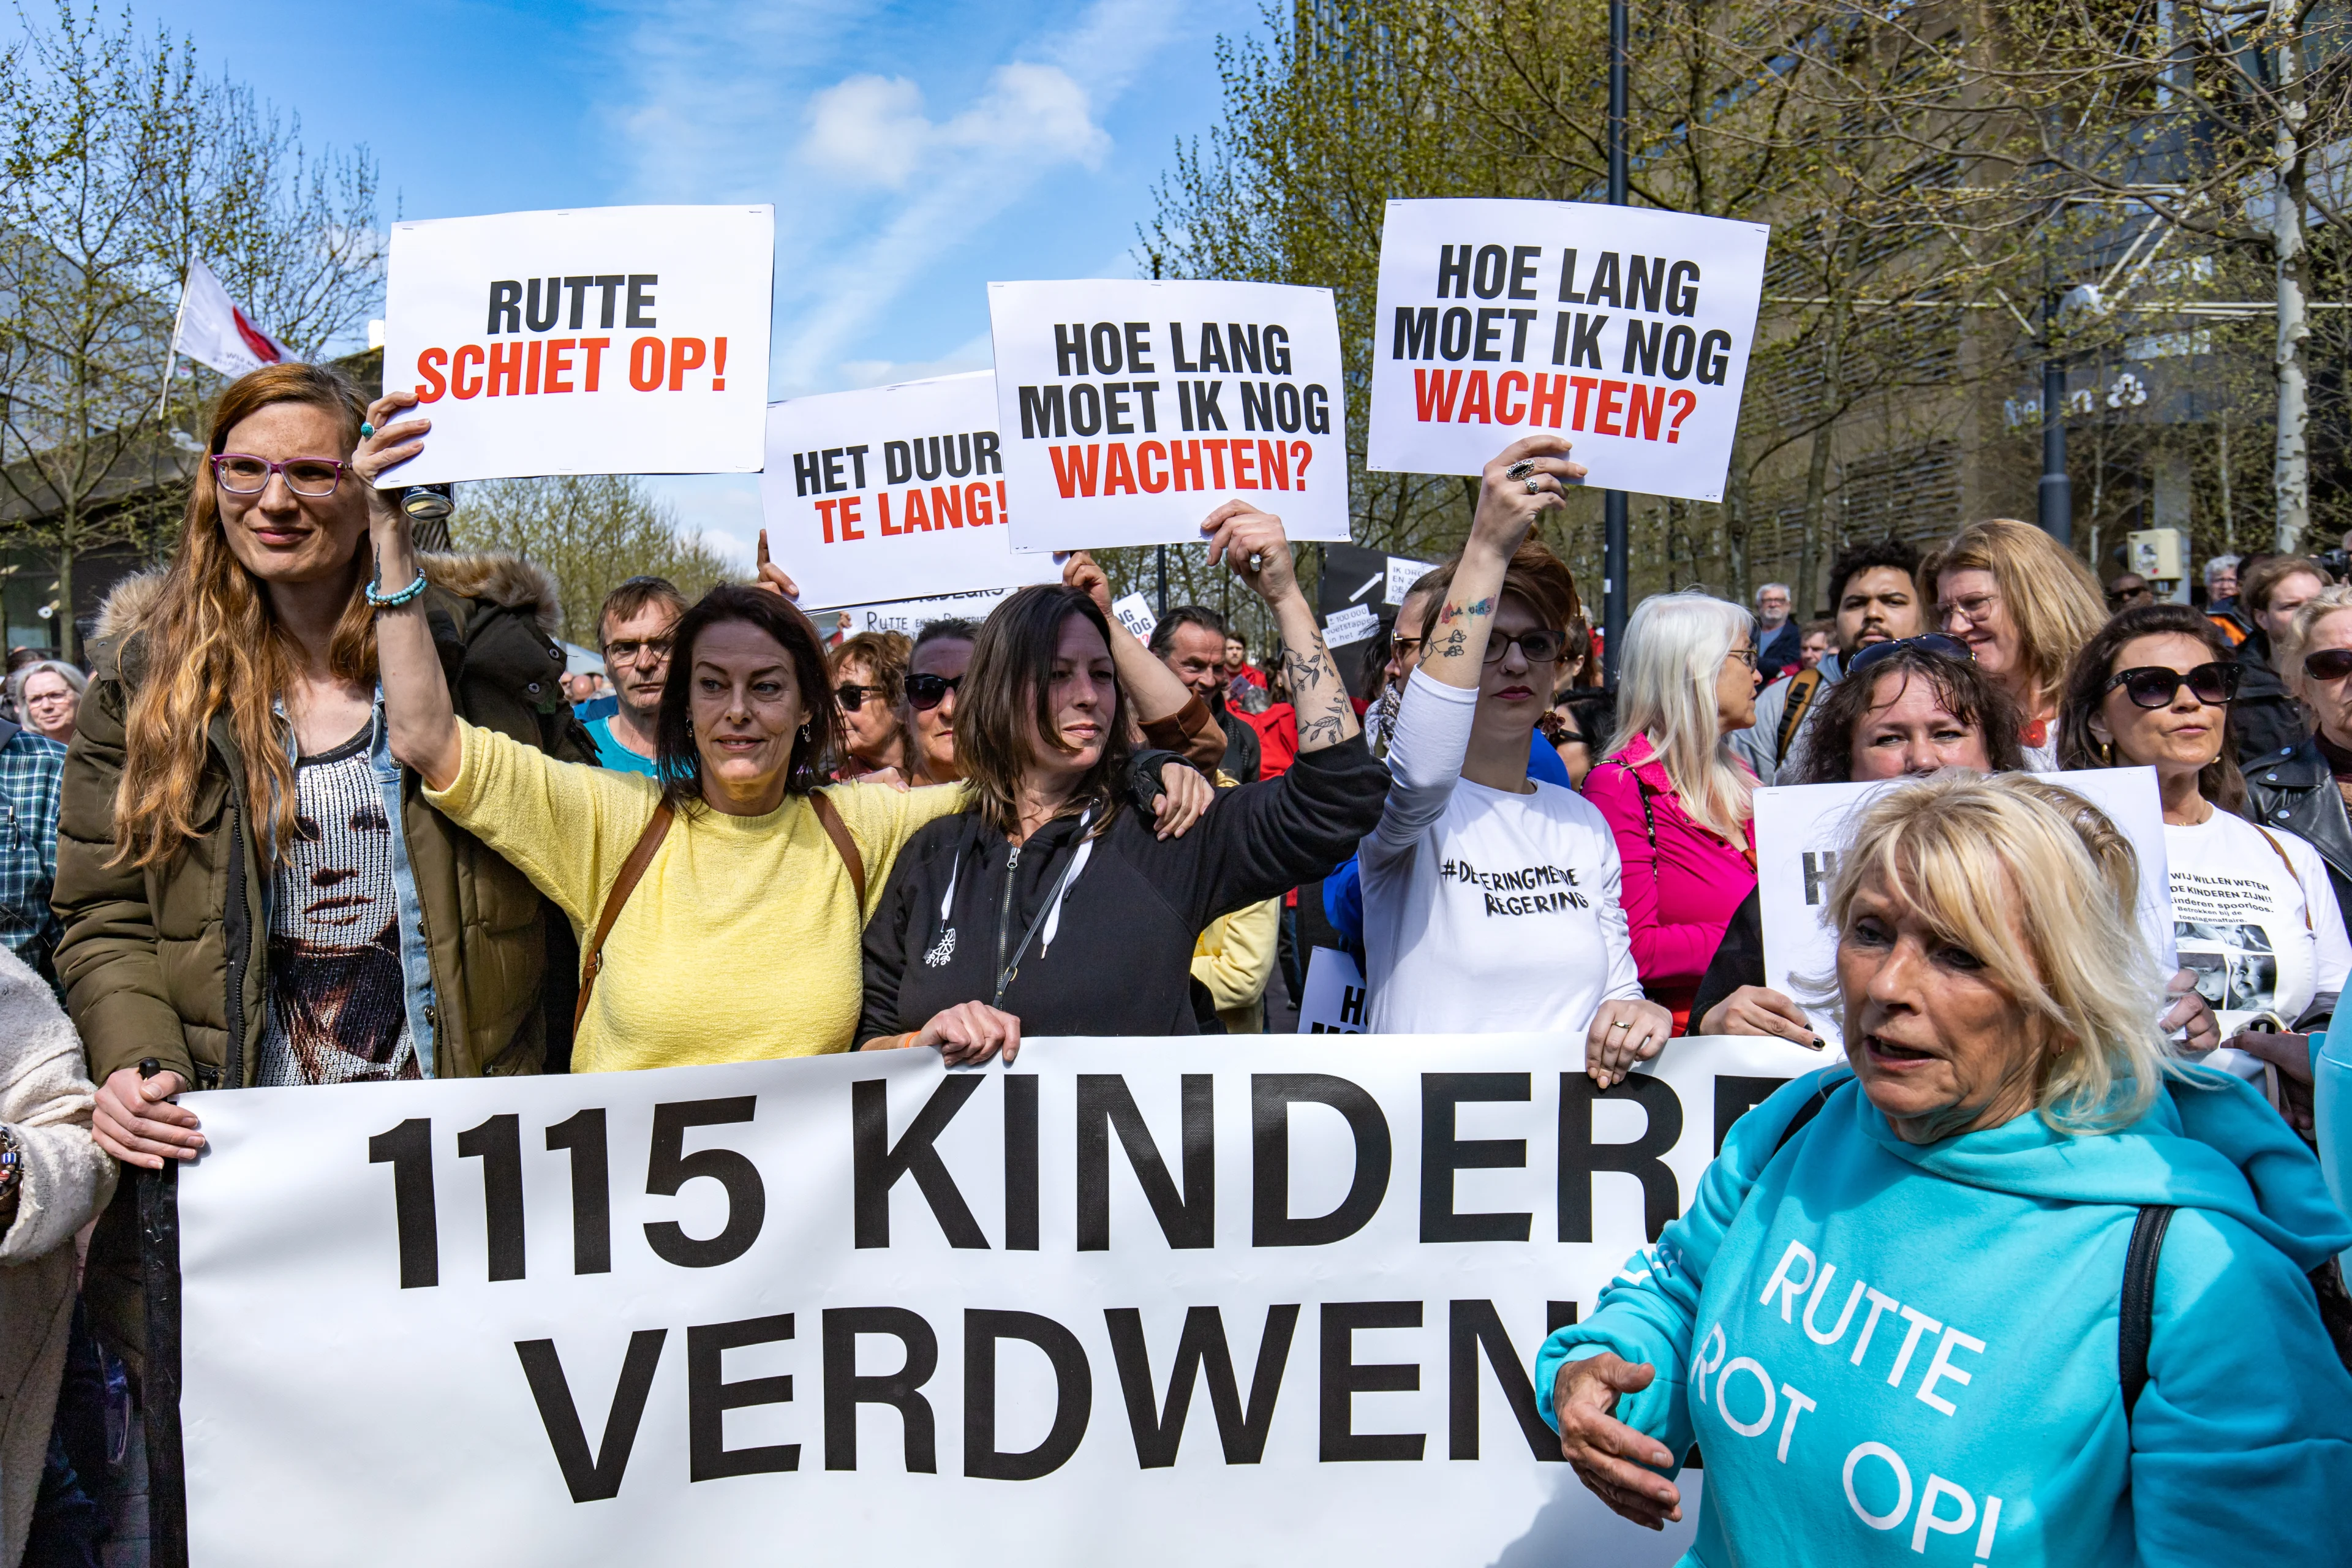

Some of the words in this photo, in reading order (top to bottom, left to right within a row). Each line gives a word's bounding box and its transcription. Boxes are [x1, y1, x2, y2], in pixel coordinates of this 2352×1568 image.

[487, 274, 658, 335] RUTTE
[1436, 244, 1542, 300] HOE
[1558, 248, 1701, 317] LANG
[415, 337, 610, 404] SCHIET
[628, 336, 728, 391] OP!
[1054, 322, 1155, 376] HOE
[1169, 322, 1292, 375] LANG
[1392, 306, 1537, 363] MOET
[1551, 312, 1609, 370] IK
[1622, 318, 1732, 386] NOG
[1018, 381, 1160, 439] MOET
[1177, 380, 1228, 432] IK
[1240, 381, 1330, 435] NOG
[1414, 368, 1697, 445] WACHTEN?
[793, 444, 870, 497] HET
[883, 431, 1003, 486] DUUR
[1048, 439, 1313, 499] WACHTEN?
[814, 496, 865, 544] TE
[877, 480, 1008, 537] LANG!
[1392, 575, 1404, 583] EN
[1340, 631, 1354, 641] het
[1484, 891, 1589, 918] REGERING
[2169, 872, 2192, 881] WIJ
[2193, 874, 2233, 886] WILLEN
[2233, 879, 2270, 892] WETEN
[2177, 906, 2217, 916] Betrokken
[2187, 886, 2241, 899] KINDEREN
[2242, 891, 2274, 903] ZIJN!!
[2217, 902, 2275, 913] spoorloos.
[2179, 914, 2248, 924] toeslagenaffaire.
[1340, 984, 1368, 1027] H
[368, 1095, 766, 1289] 1115
[1759, 1240, 1986, 1417] RUTTE
[1689, 1321, 1817, 1465] ROT
[1842, 1441, 2002, 1568] OP!
